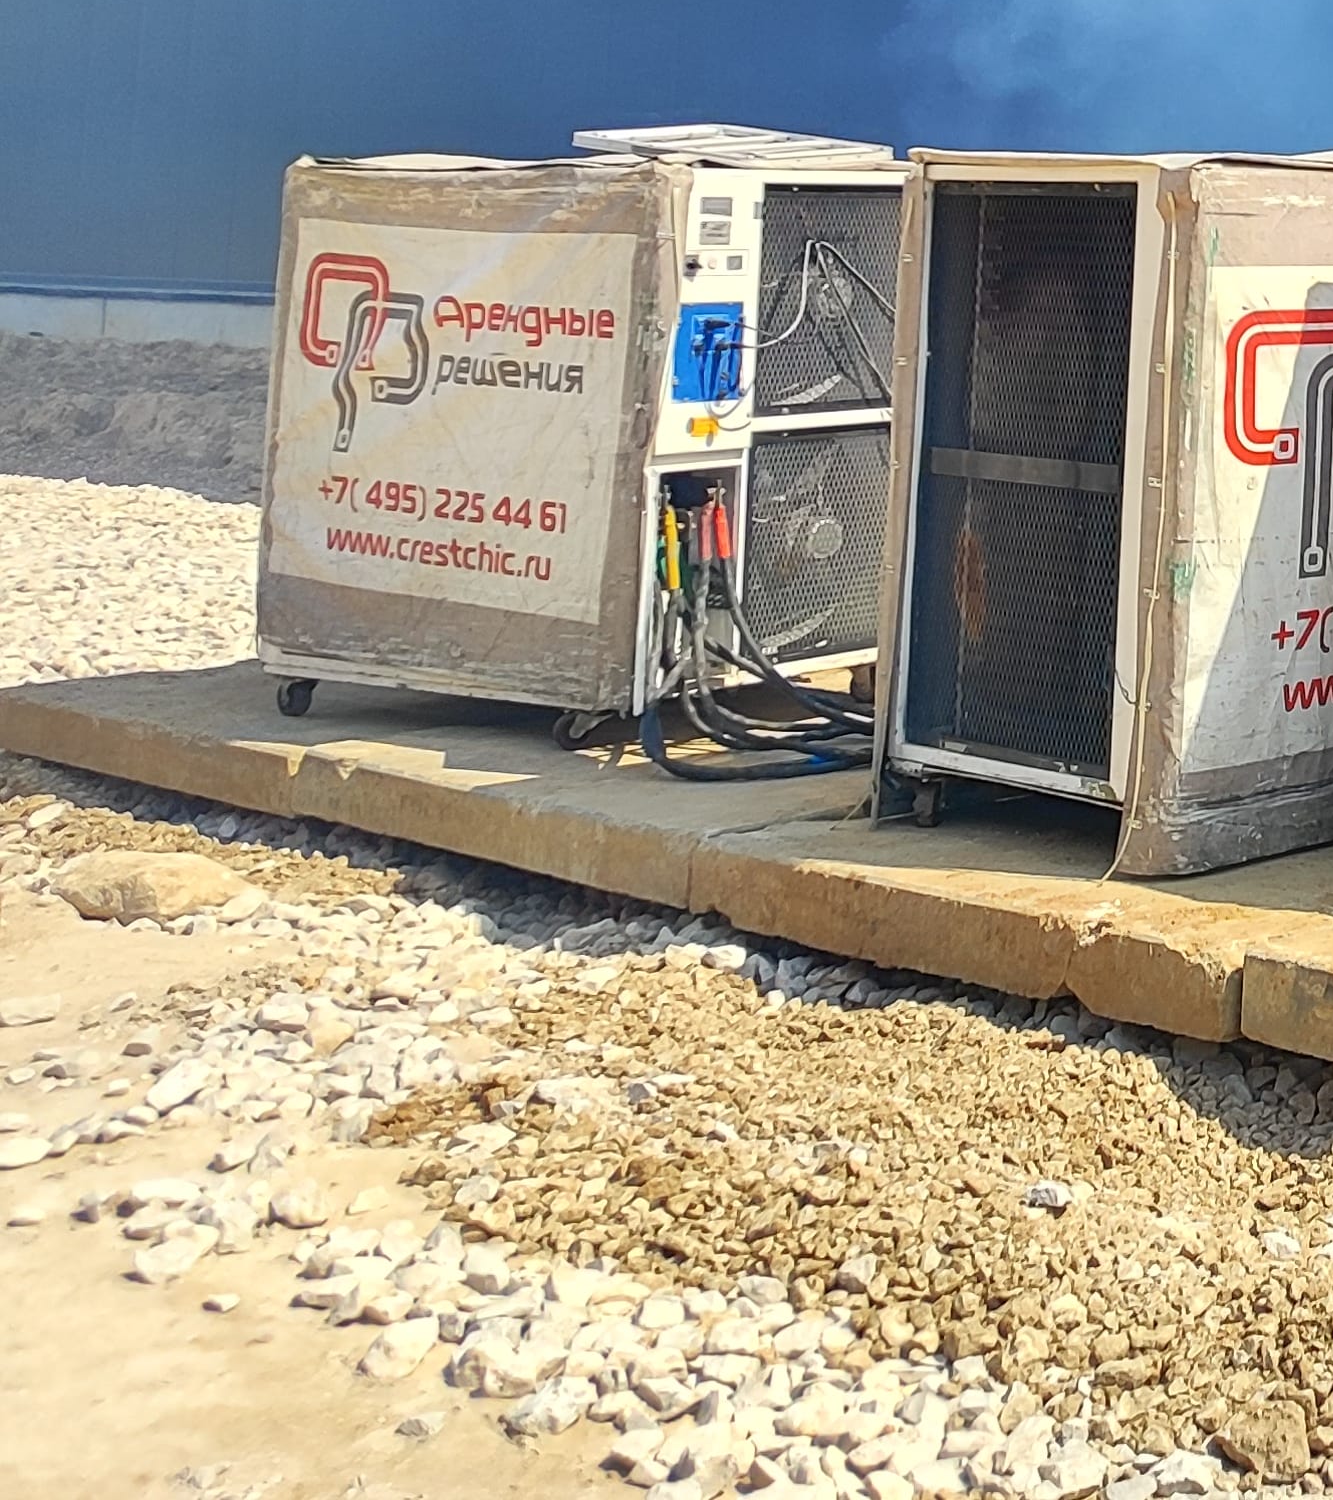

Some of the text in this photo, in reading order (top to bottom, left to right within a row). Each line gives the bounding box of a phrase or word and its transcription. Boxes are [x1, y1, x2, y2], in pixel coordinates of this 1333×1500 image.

[433, 296, 615, 347] Арендные
[431, 354, 584, 395] решения
[434, 488, 485, 523] 225
[492, 496, 532, 529] 44
[539, 501, 567, 534] 61
[327, 527, 551, 581] www.crestchic.ru
